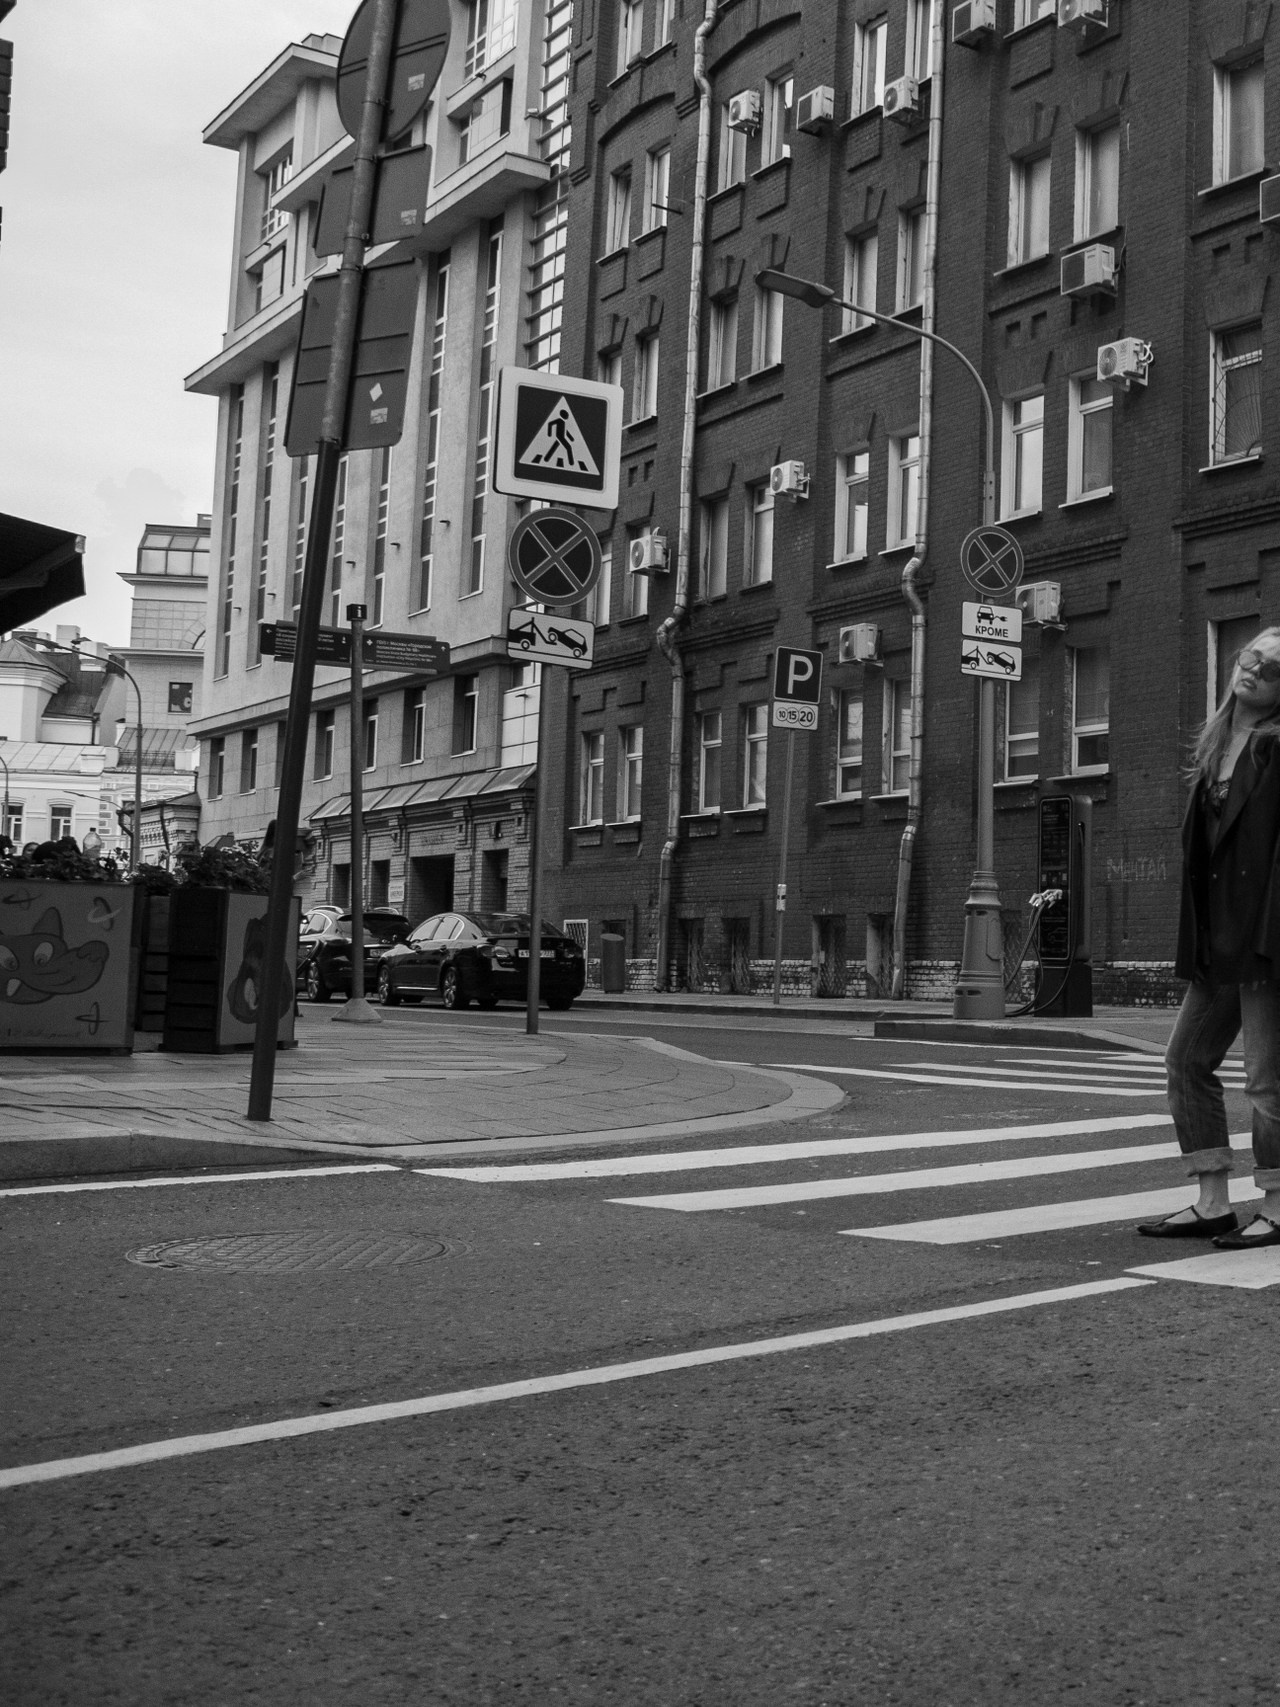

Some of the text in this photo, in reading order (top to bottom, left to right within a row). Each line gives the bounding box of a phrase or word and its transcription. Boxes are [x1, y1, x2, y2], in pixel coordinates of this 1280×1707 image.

[975, 625, 1009, 638] КРОМЕ
[787, 654, 814, 694] P
[778, 710, 813, 723] 10 15 20
